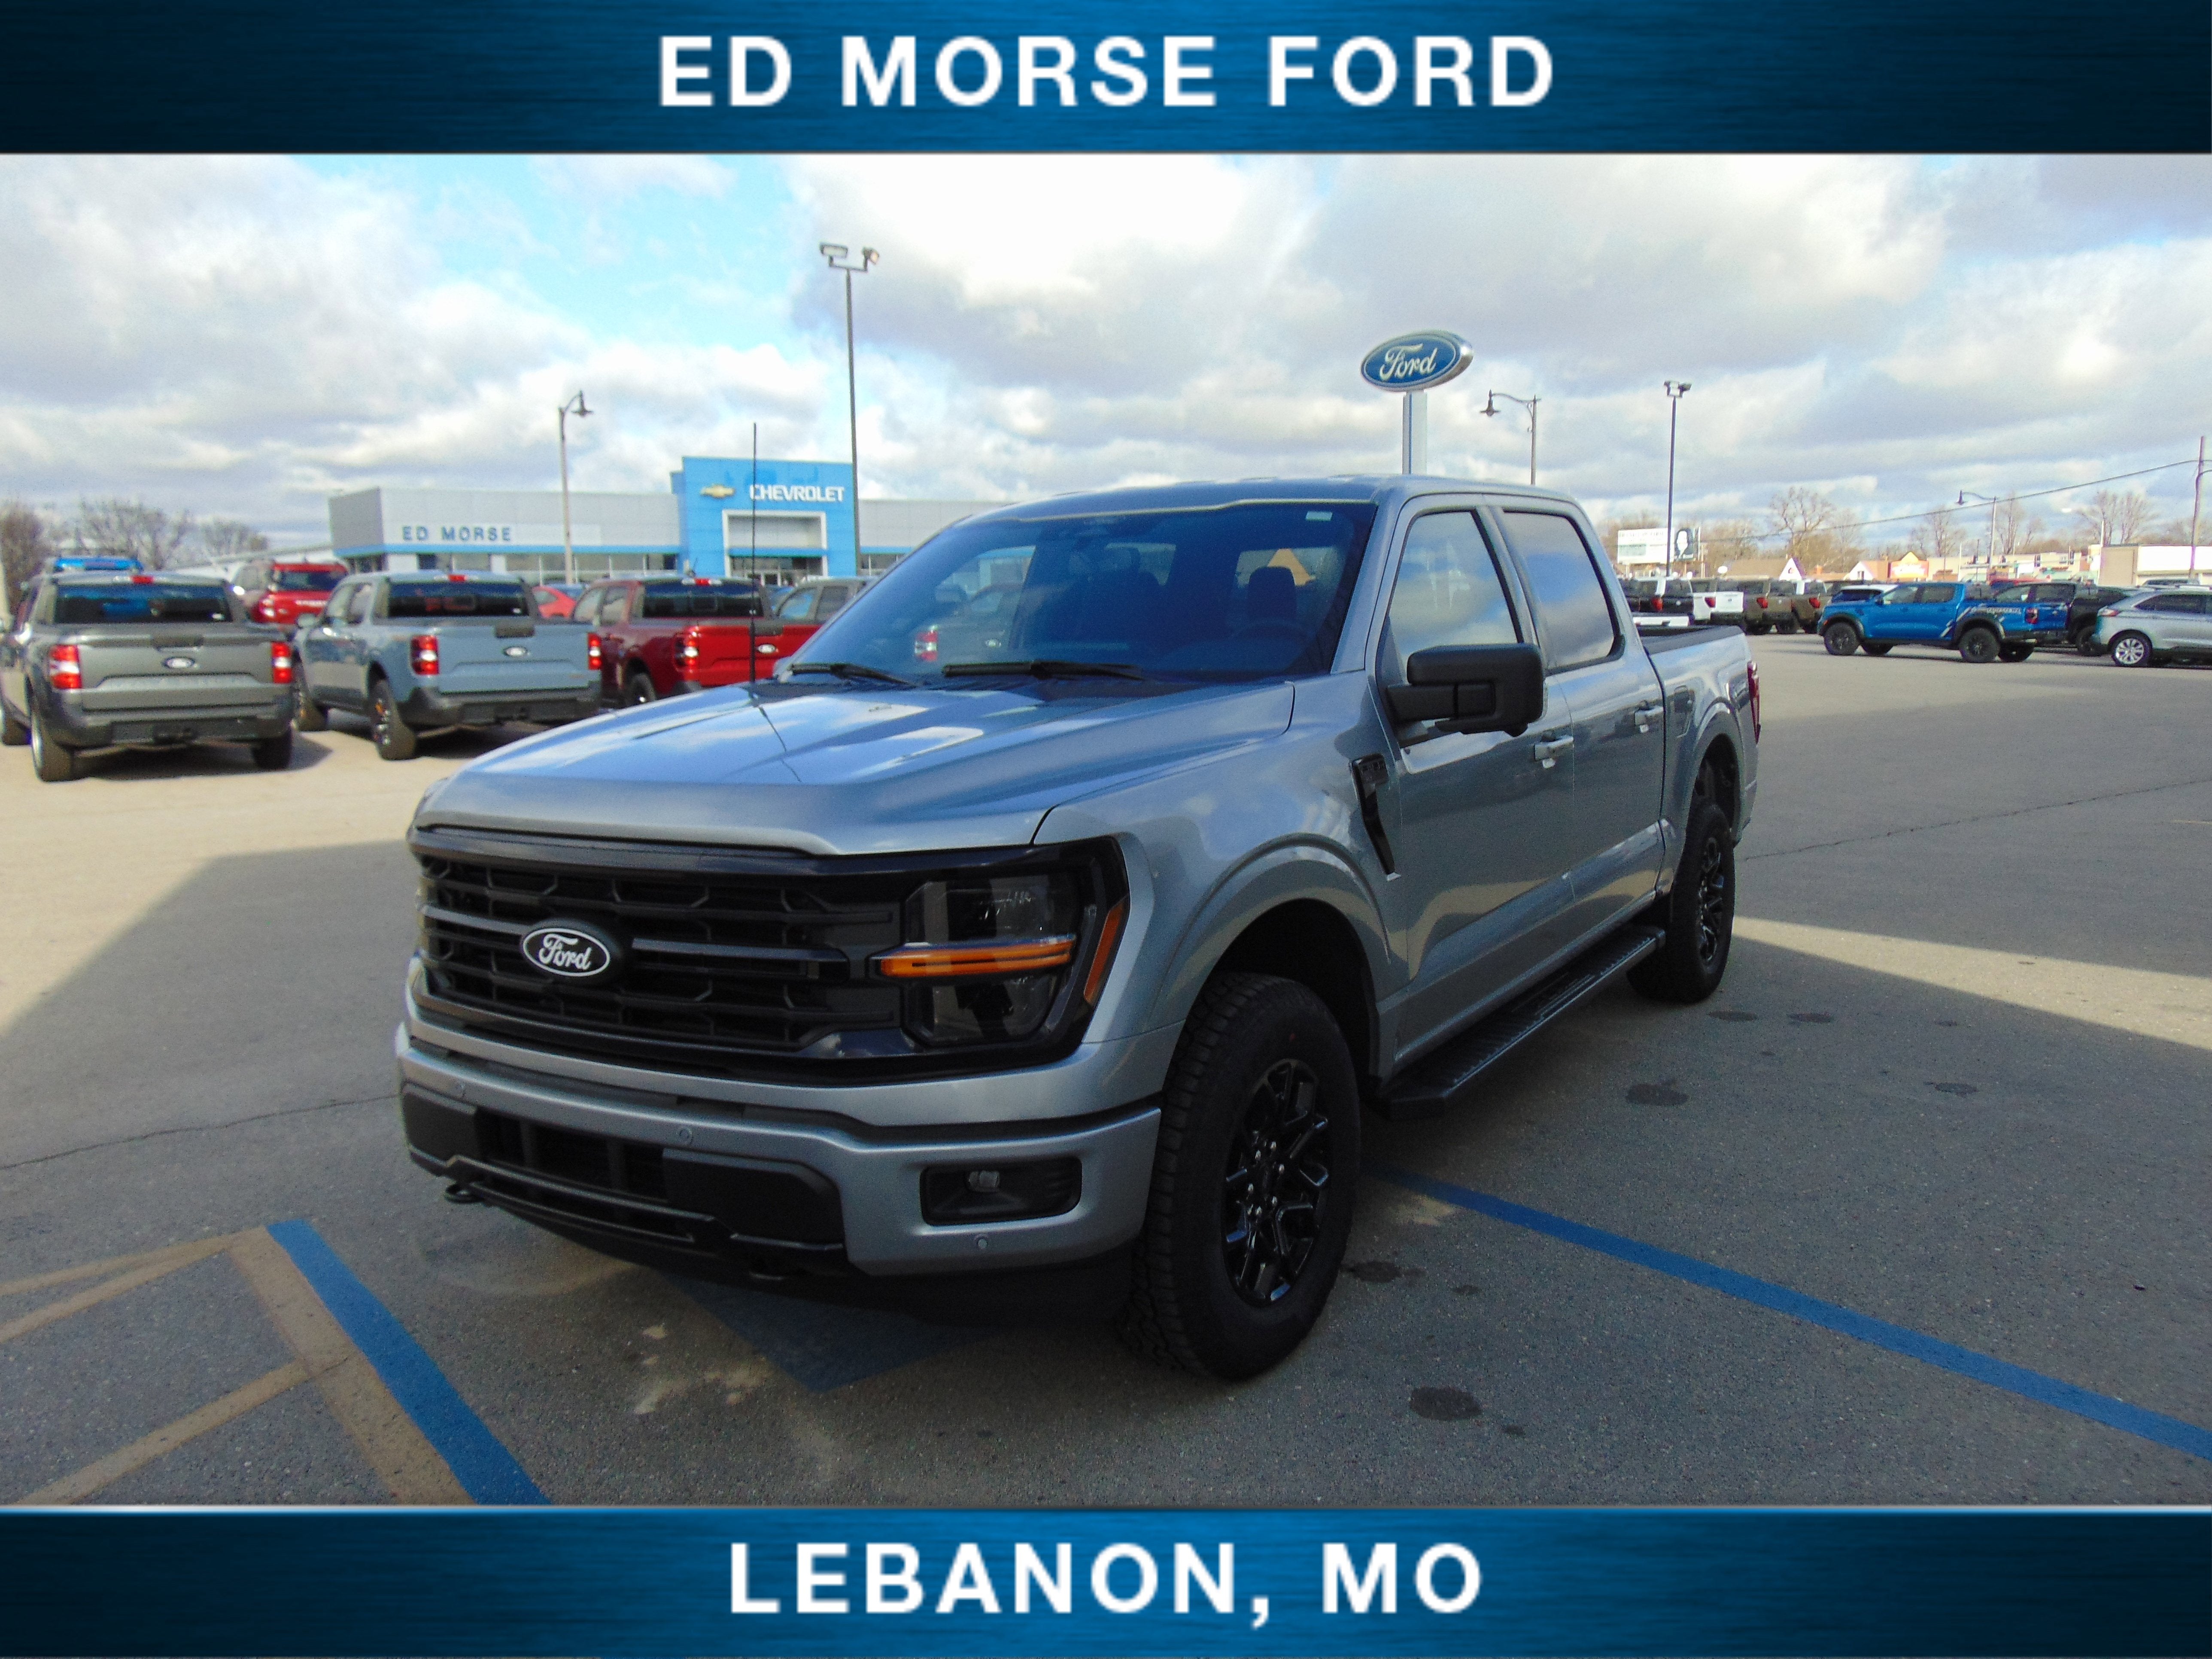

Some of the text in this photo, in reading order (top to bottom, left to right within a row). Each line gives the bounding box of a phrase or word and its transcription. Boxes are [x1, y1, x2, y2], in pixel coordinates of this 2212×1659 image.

[1379, 343, 1437, 381] Ford
[750, 484, 844, 502] CHEVROLET
[403, 526, 511, 541] ED MORSE
[539, 933, 592, 970] Ford
